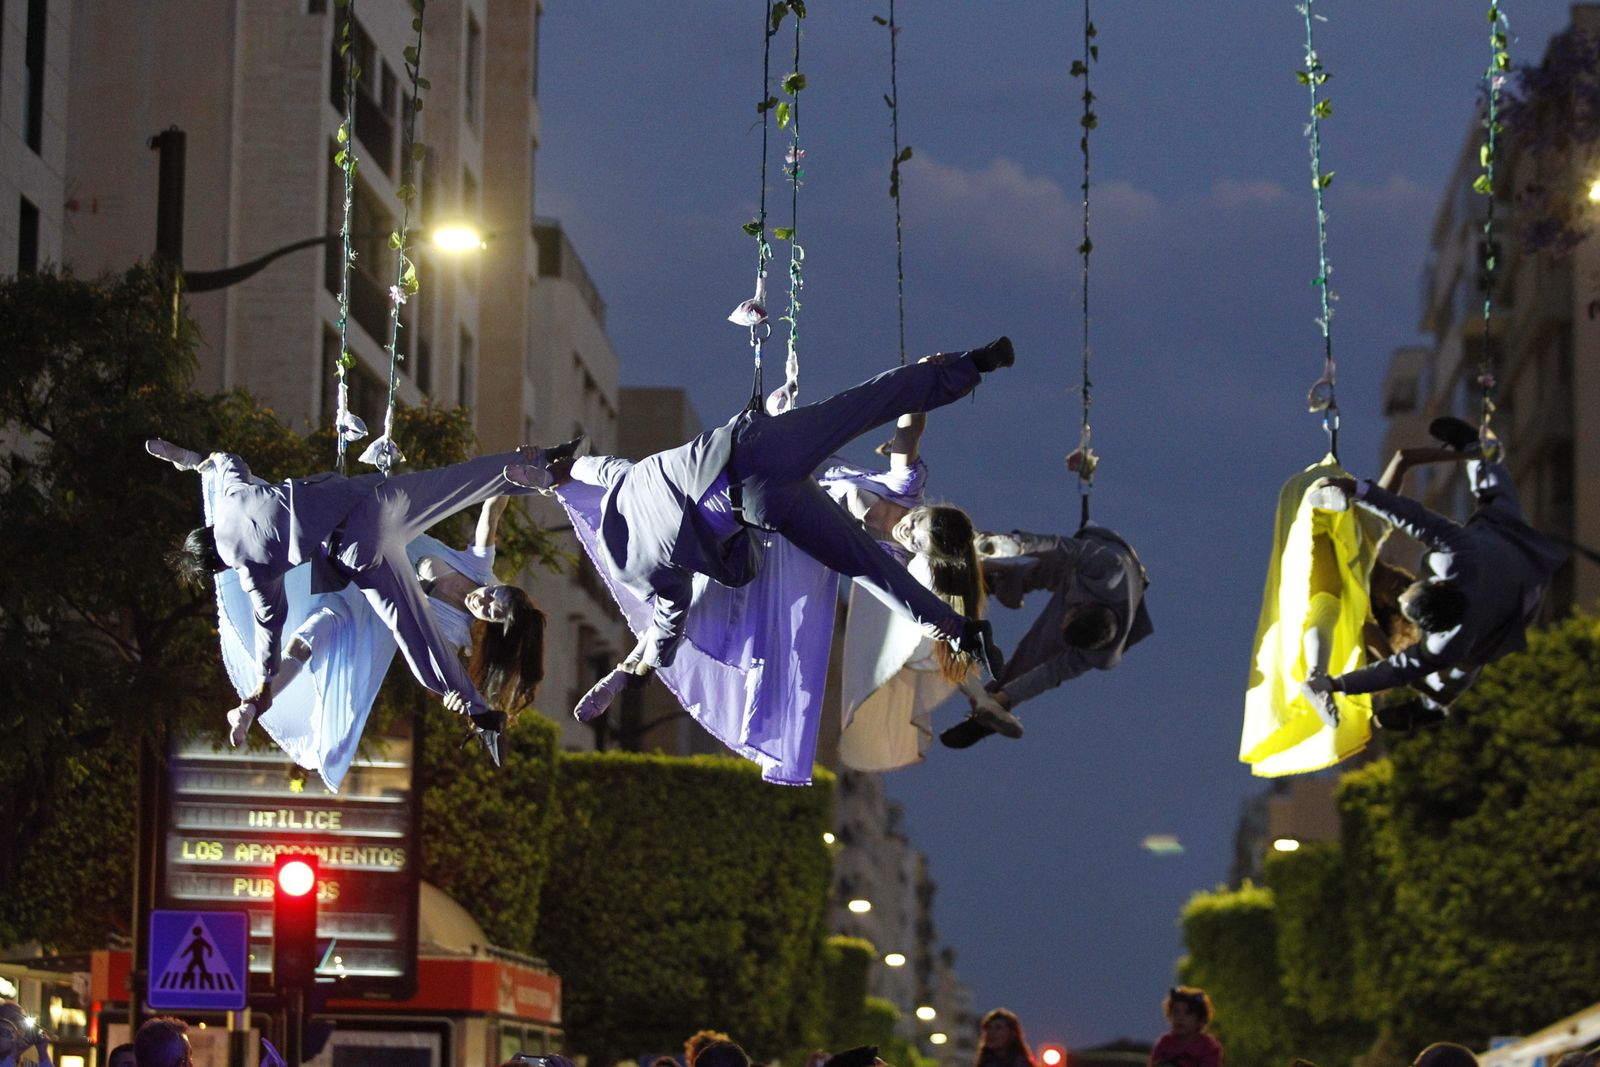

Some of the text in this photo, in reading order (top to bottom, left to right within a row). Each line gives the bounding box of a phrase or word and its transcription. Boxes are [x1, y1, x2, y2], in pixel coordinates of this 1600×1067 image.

[248, 808, 343, 830] UTILICE
[181, 841, 224, 861] LOS
[233, 878, 341, 899] PUBOS
